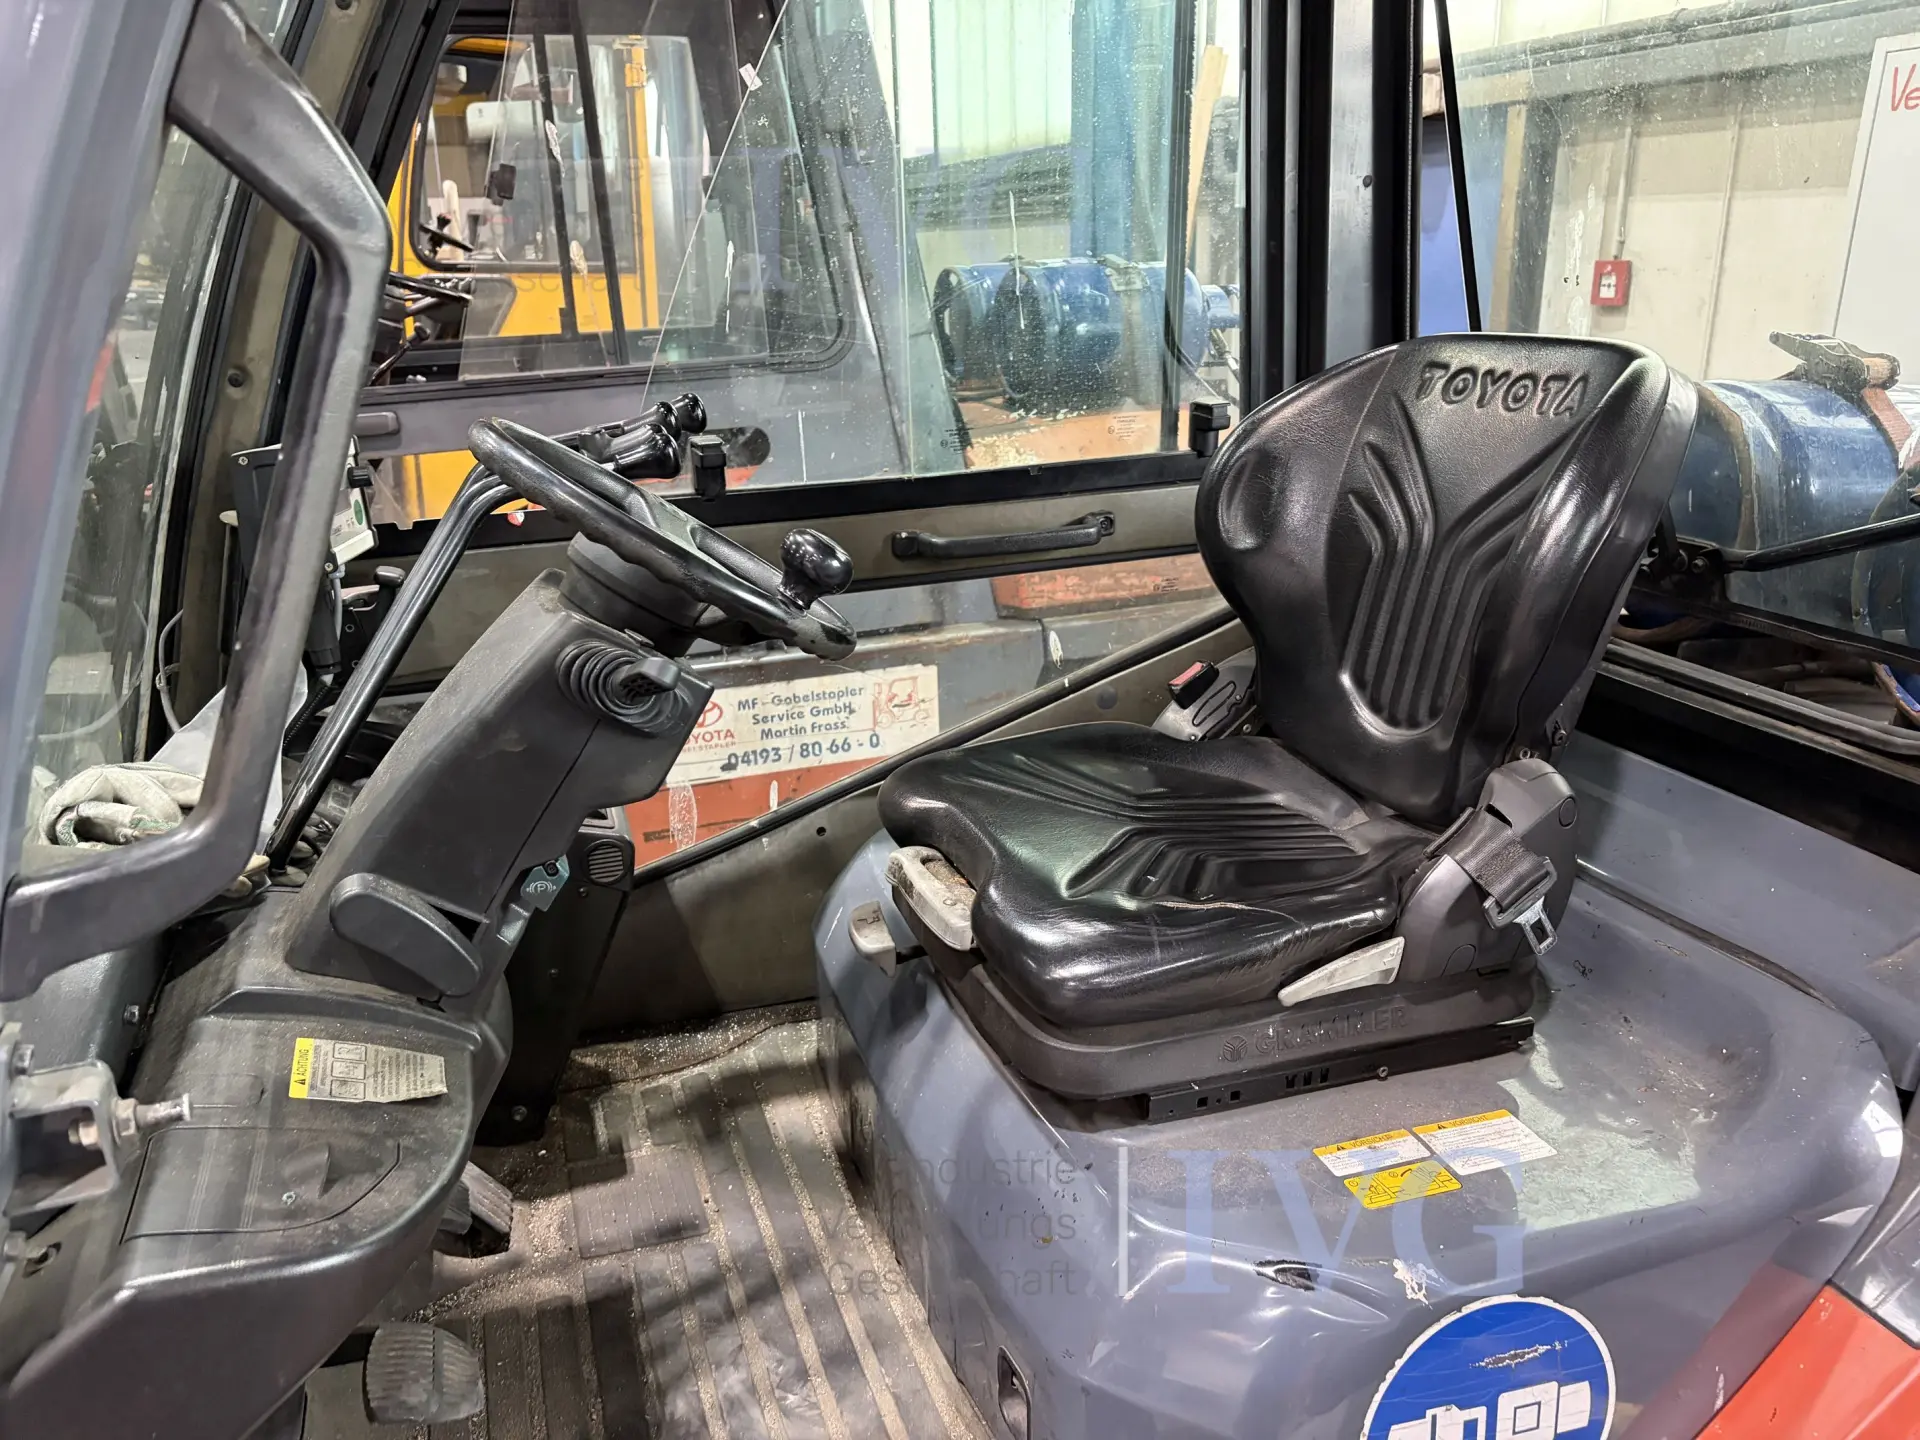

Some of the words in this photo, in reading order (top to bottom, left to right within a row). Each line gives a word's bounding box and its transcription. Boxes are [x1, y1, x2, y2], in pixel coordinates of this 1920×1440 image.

[1416, 360, 1590, 417] TOYOTA
[737, 697, 759, 712] MF
[771, 686, 865, 707] Gabelstapler
[752, 709, 805, 726] Service
[810, 701, 853, 718] GmbH
[685, 728, 736, 745] YOTA
[760, 724, 807, 741] Martin
[727, 745, 783, 768] 04193
[799, 740, 823, 759] 80
[829, 736, 851, 755] 66
[868, 733, 880, 749] 0
[1256, 1005, 1408, 1054] GRAMMER
